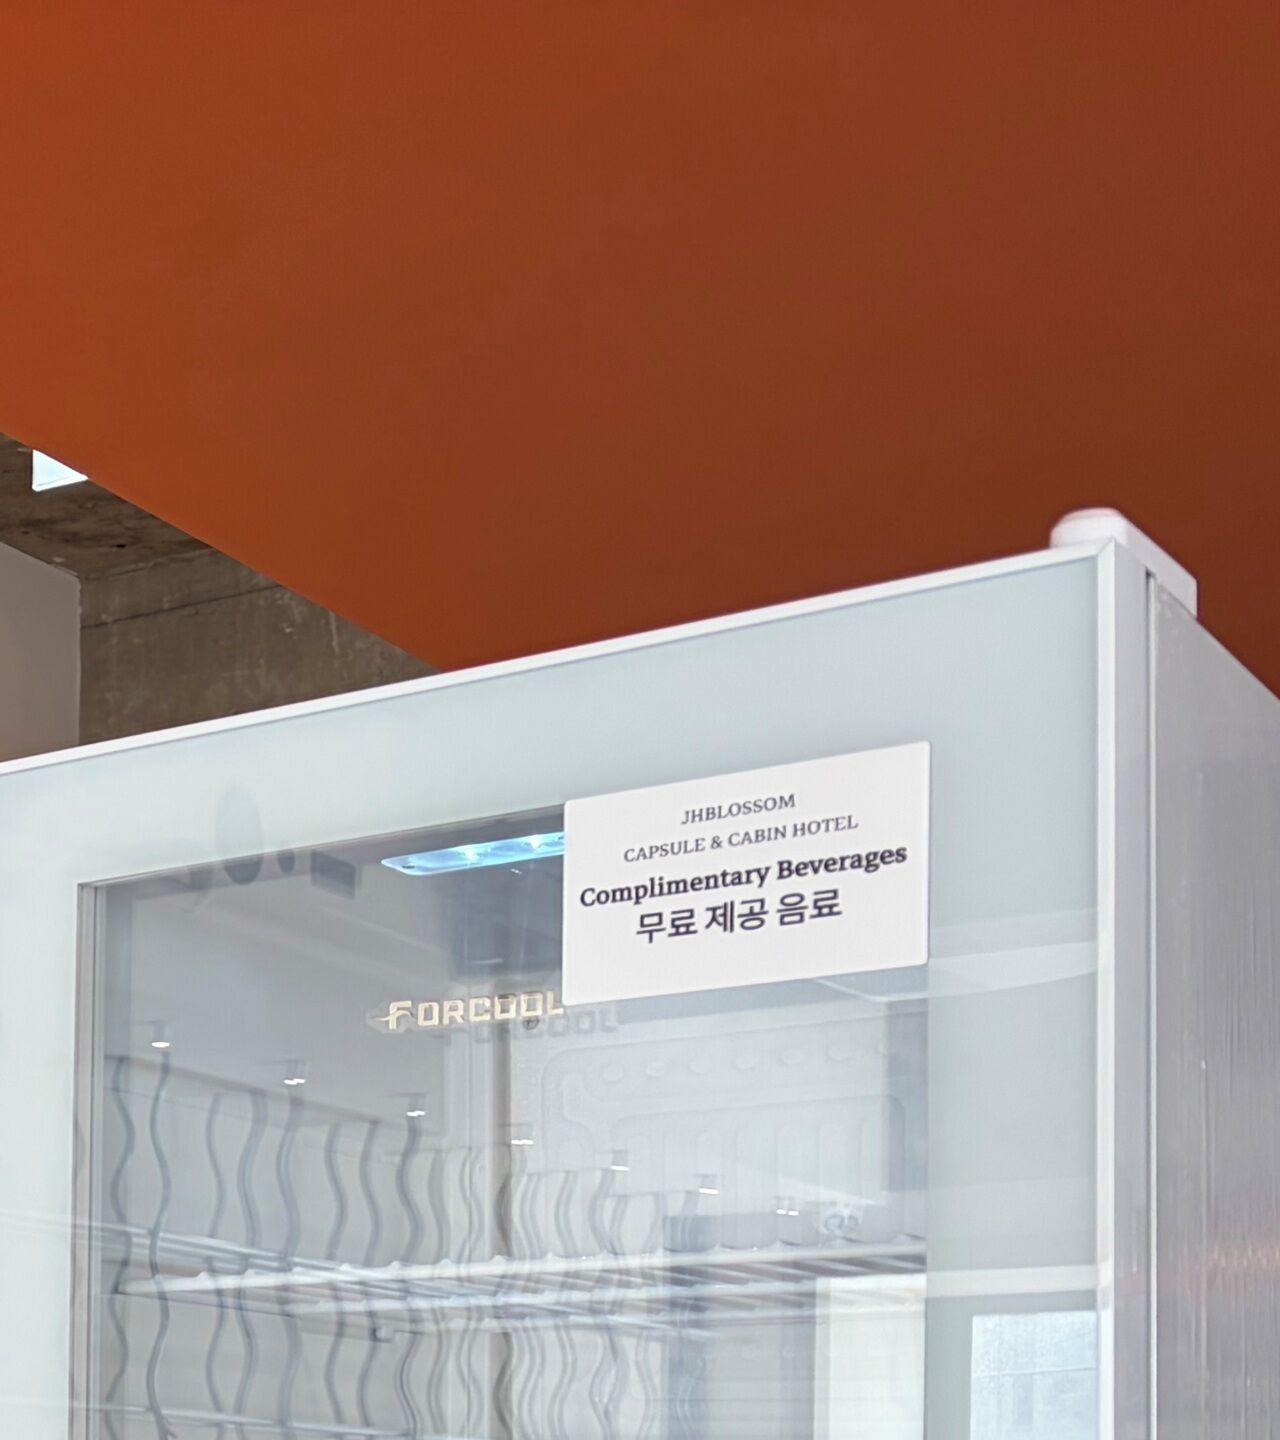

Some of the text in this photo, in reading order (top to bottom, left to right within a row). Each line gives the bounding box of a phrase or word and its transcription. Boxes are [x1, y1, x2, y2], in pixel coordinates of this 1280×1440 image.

[679, 792, 797, 826] JHBLOSSOM
[623, 814, 860, 864] CAPSULE & CABIN HOTEL
[579, 845, 909, 909] Complimentary Beverages
[635, 888, 842, 944] 무료 제공 음료
[375, 991, 565, 1030] FORCOOL
